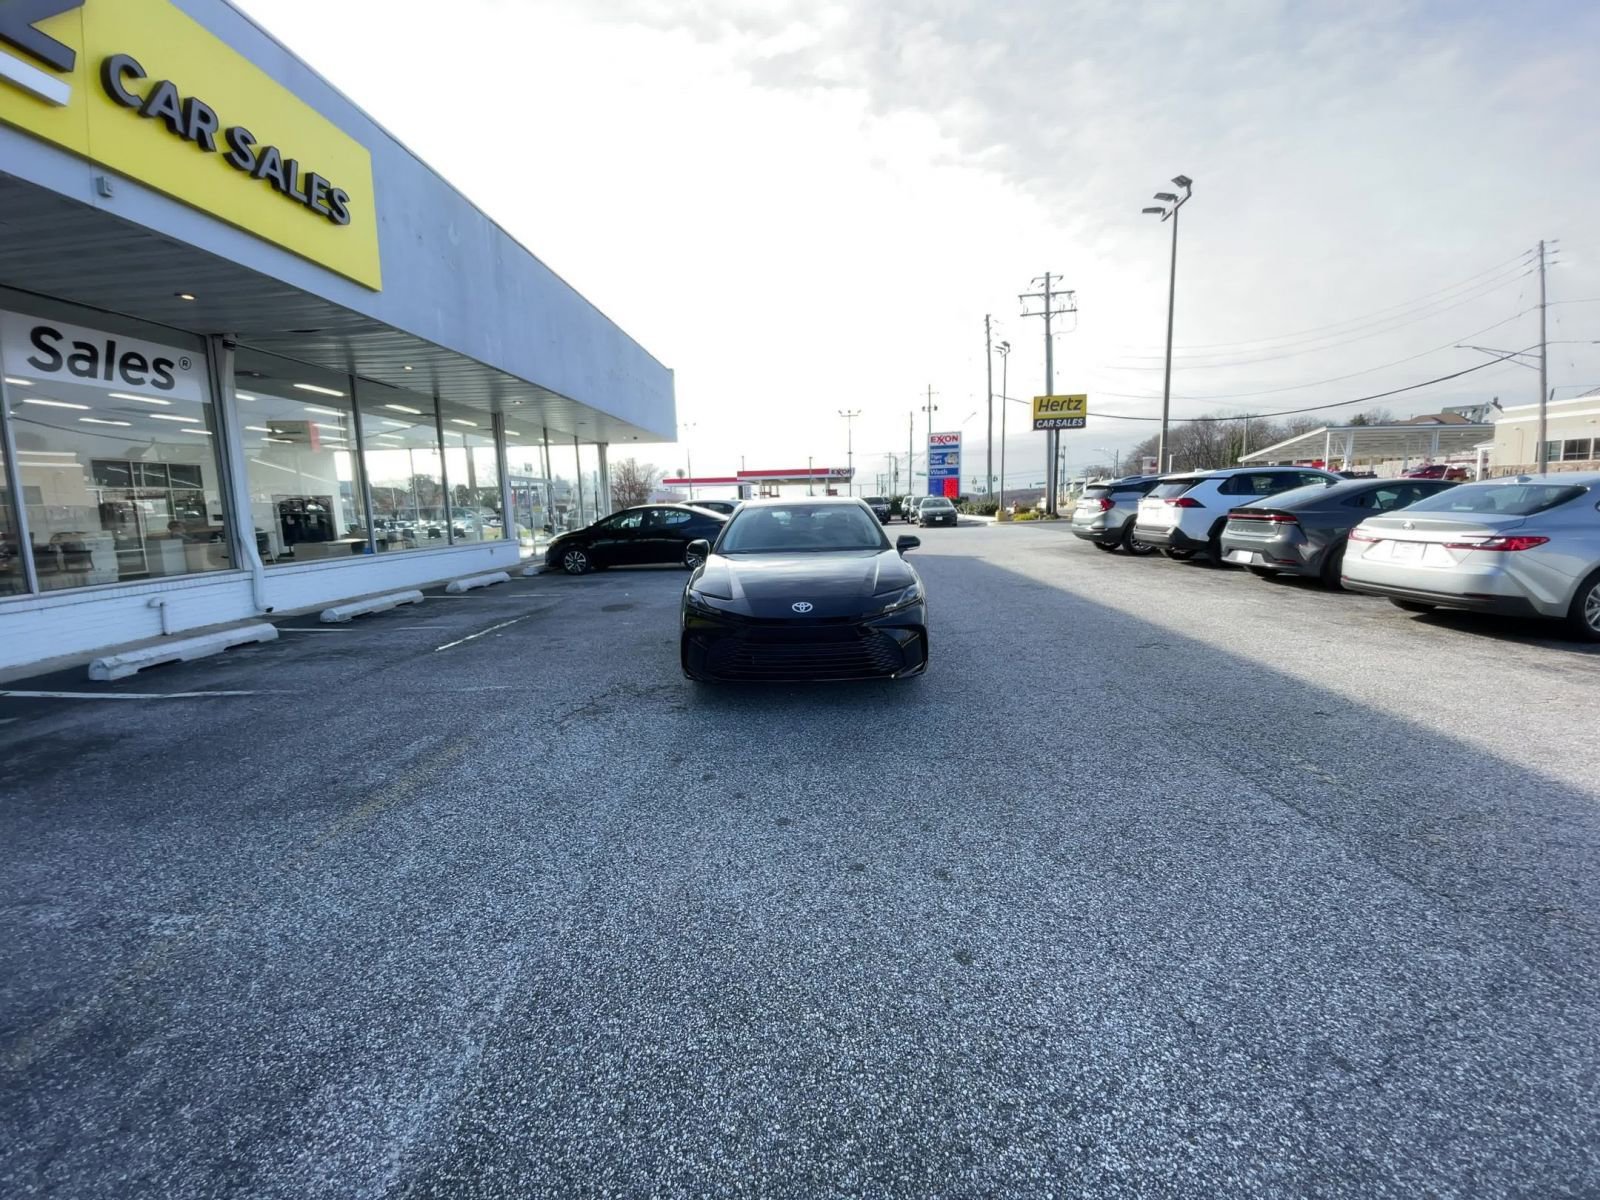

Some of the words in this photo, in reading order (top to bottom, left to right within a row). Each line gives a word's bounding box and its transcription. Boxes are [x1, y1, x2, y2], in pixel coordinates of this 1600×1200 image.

[100, 53, 219, 153] CAR
[223, 126, 351, 226] SALES
[1038, 397, 1083, 412] Hertz
[1036, 419, 1055, 428] CAR
[1056, 418, 1083, 427] SALES
[930, 435, 959, 444] EXXON
